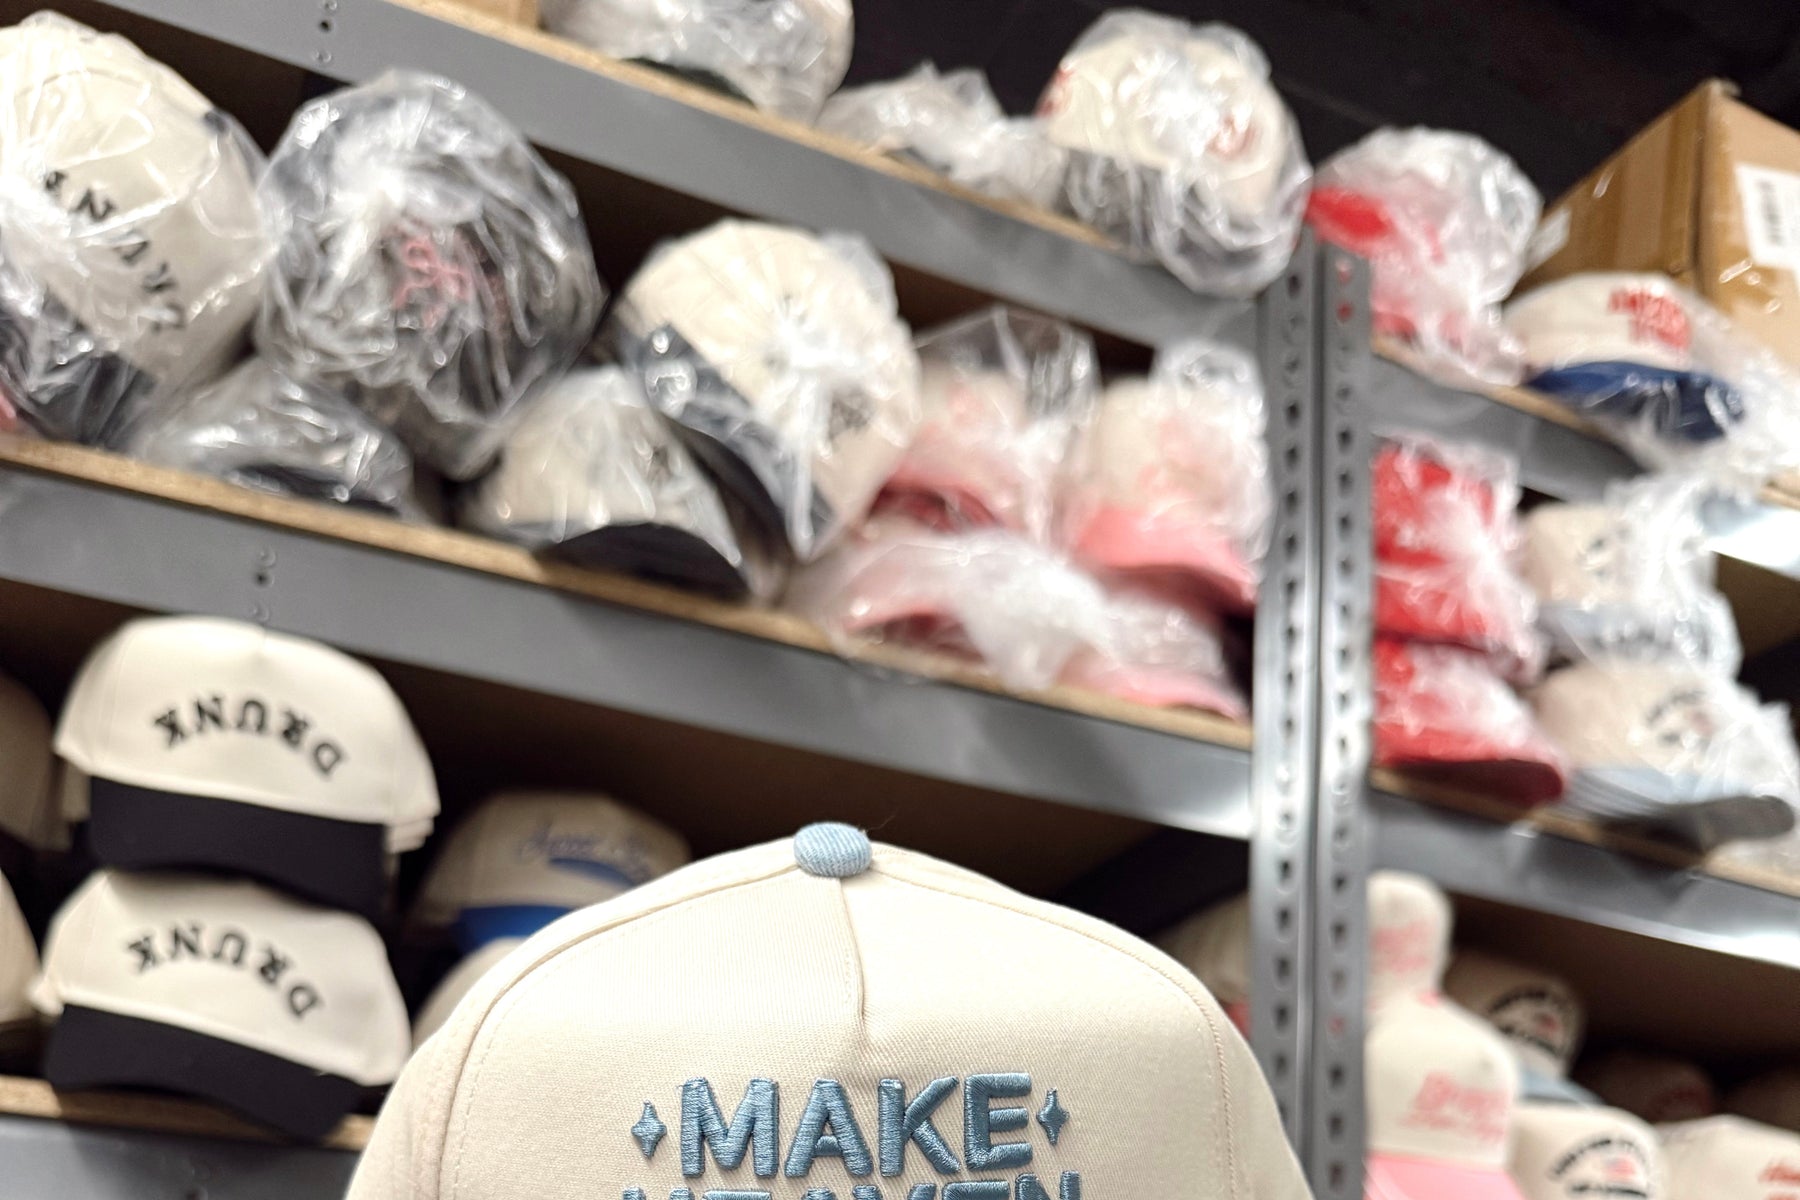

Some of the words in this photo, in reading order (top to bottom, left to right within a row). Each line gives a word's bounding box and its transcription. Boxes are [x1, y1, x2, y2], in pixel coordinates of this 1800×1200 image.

[153, 696, 345, 776] DRUNK
[124, 922, 325, 1020] DRUNK
[680, 1071, 1034, 1178] MAKE
